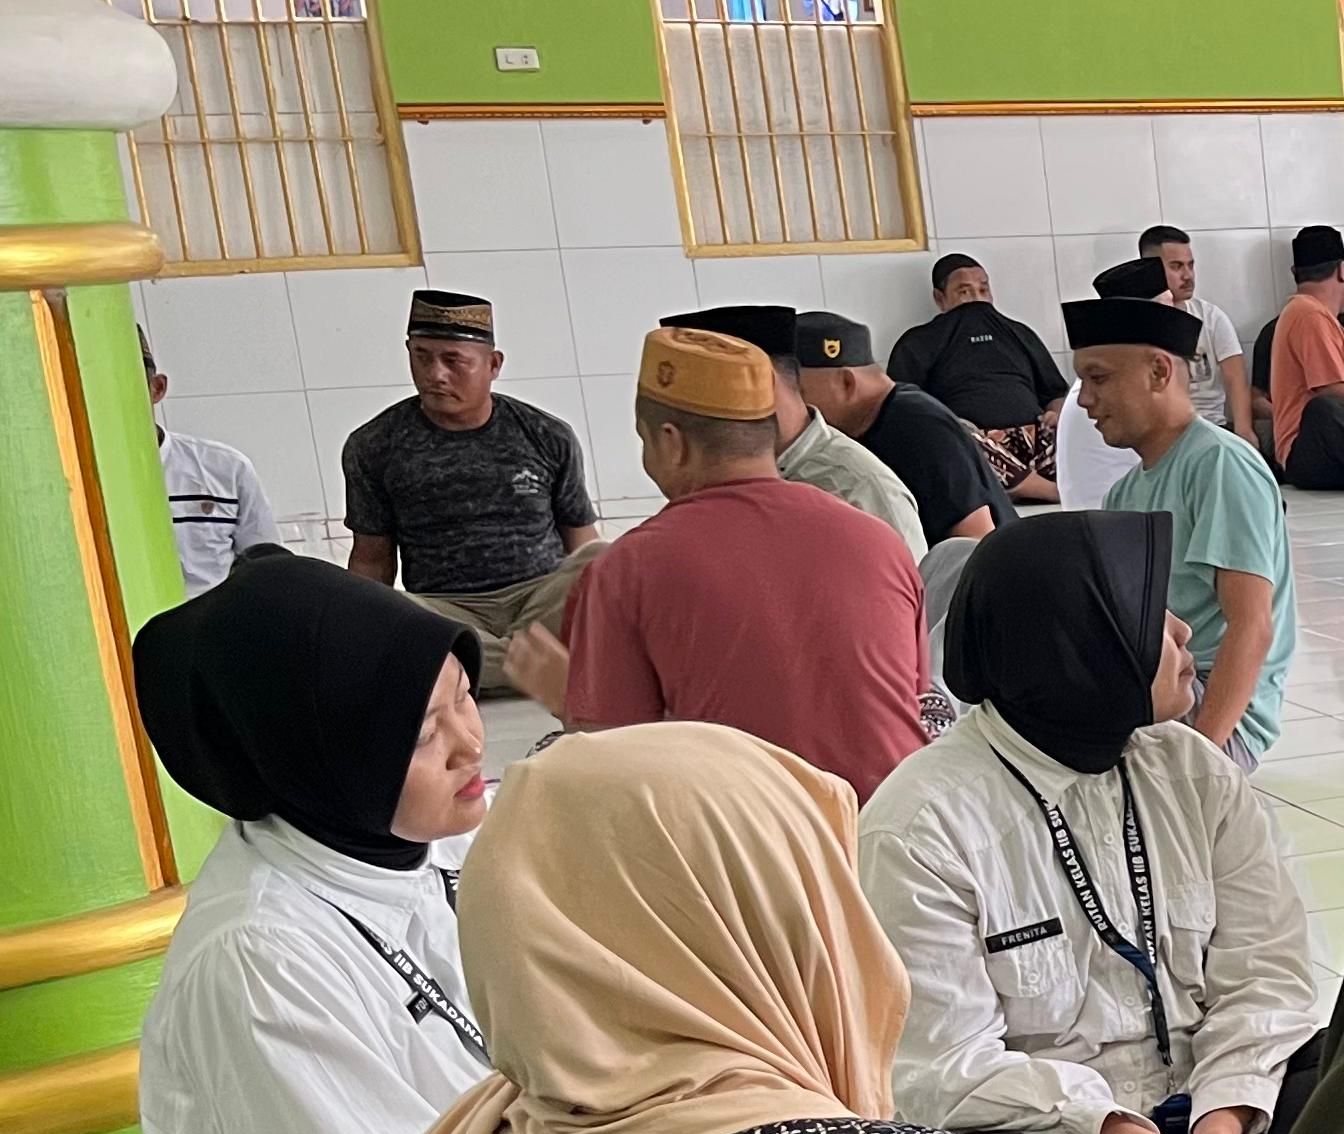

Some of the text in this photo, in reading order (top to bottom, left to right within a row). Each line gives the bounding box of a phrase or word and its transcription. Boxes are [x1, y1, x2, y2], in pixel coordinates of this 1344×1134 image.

[1055, 829, 1070, 848] IIB
[1062, 848, 1087, 888] KELAS
[1131, 856, 1146, 874] IIB
[1080, 891, 1108, 931] RUTAN
[1136, 877, 1153, 916] KELAS
[1000, 926, 1048, 946] FRENITA
[394, 953, 484, 1047] IIB SUKADANA
